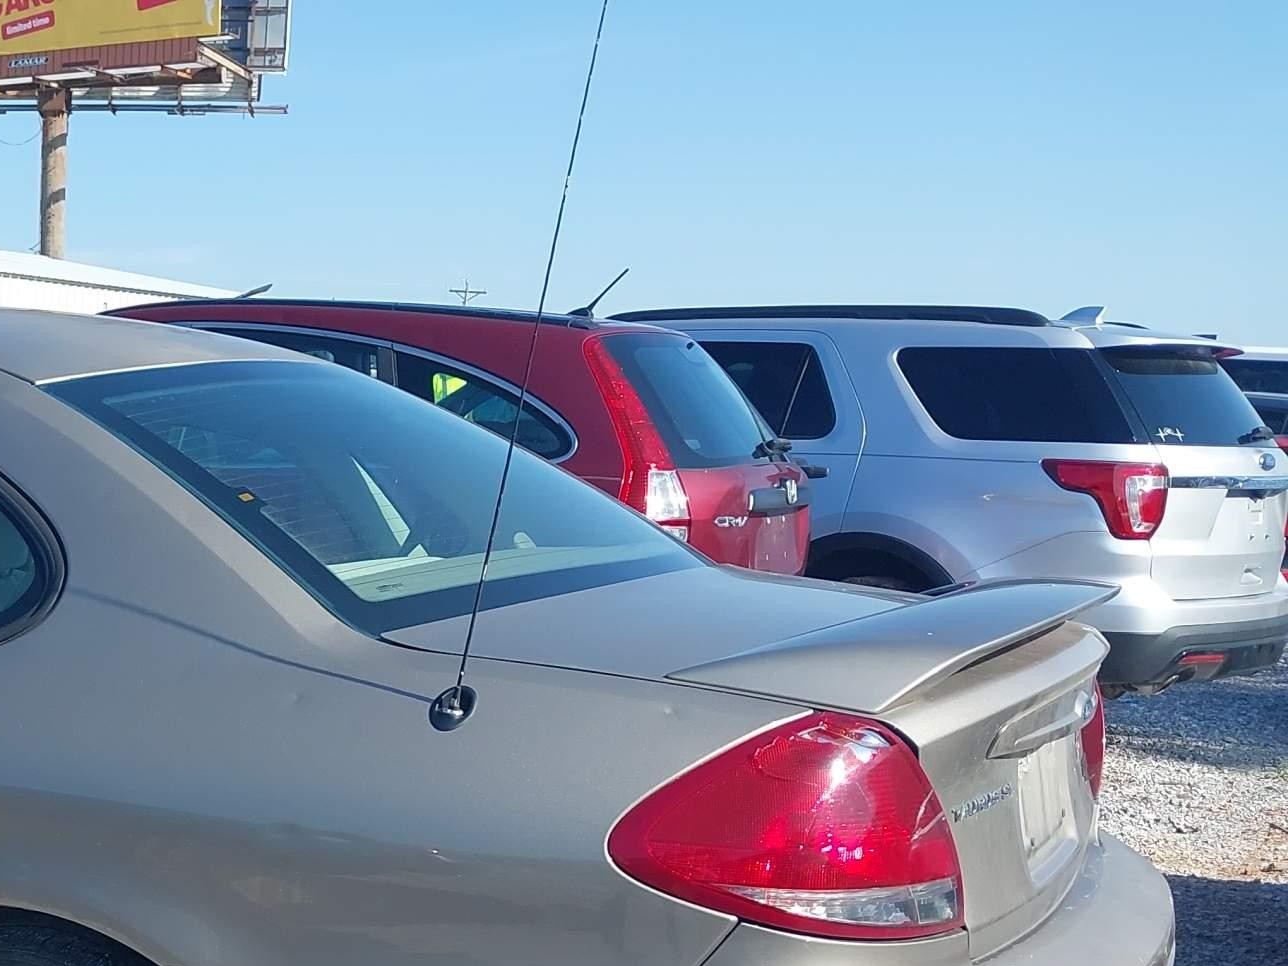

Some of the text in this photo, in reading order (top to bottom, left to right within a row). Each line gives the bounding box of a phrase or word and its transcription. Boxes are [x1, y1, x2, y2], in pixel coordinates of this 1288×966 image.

[6, 16, 50, 35] limited time
[9, 56, 48, 69] LAMAR
